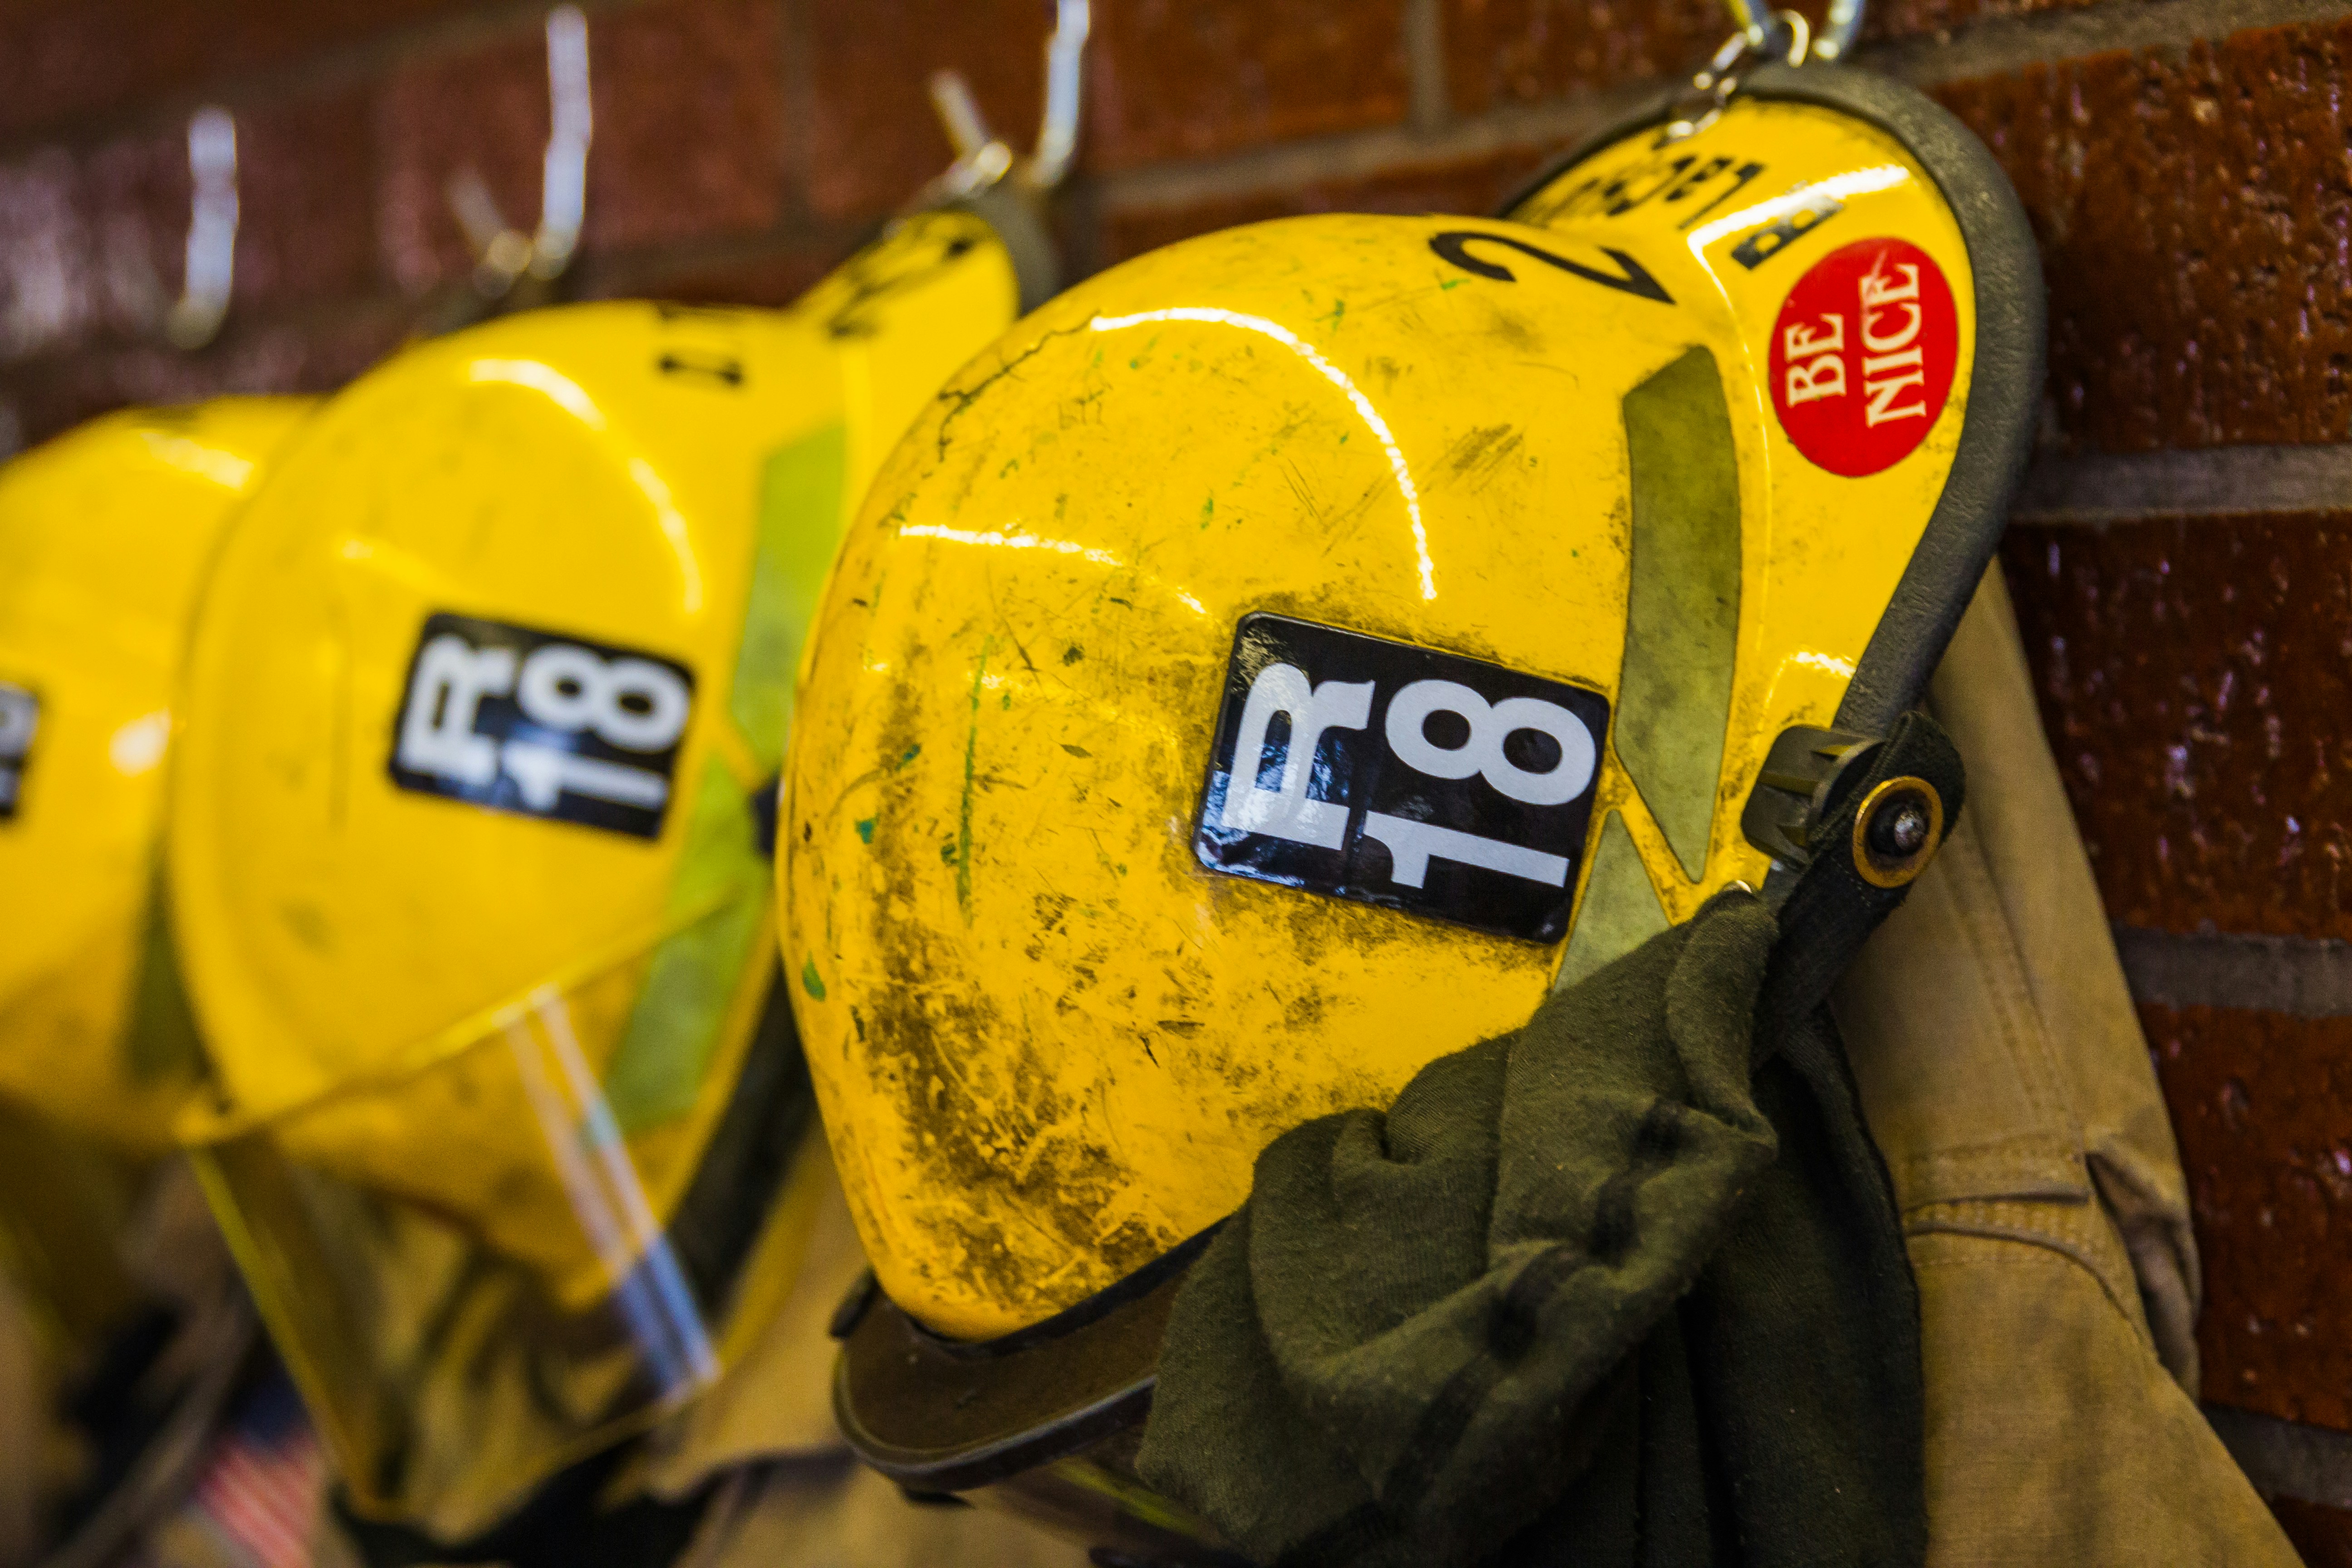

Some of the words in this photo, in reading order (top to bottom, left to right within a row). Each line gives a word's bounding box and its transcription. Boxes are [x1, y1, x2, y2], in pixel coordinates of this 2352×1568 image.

[1428, 230, 1677, 306] 2
[1857, 262, 1927, 428] NICE
[1783, 312, 1847, 408] BE
[396, 632, 518, 789] R
[500, 641, 692, 813] 18
[1220, 662, 1377, 851] R
[1362, 678, 1597, 889] 18
